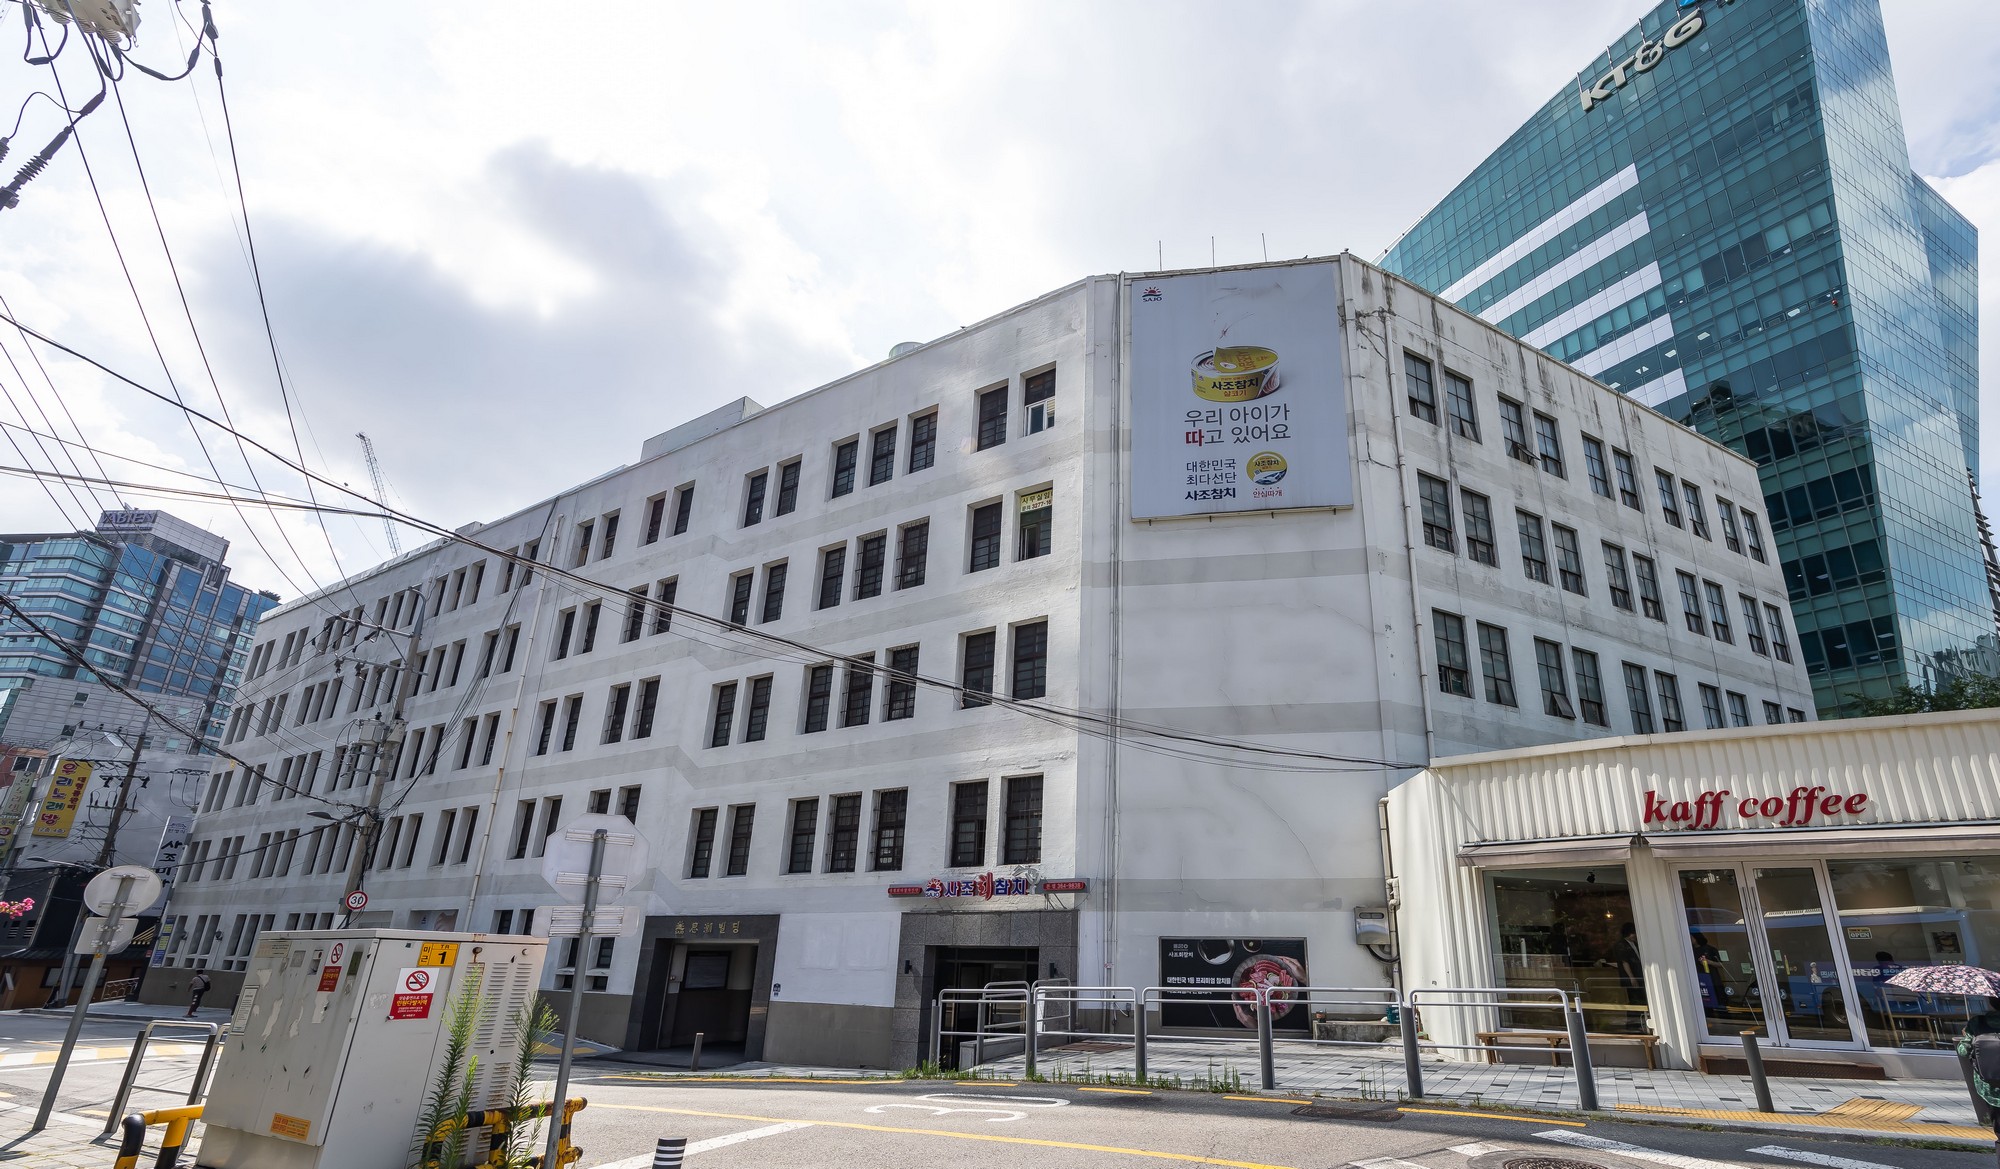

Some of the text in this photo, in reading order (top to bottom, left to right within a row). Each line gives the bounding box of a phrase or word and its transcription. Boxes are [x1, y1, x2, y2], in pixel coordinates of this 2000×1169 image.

[1579, 7, 1704, 112] KT&G
[1211, 377, 1259, 391] 사조참치
[1184, 403, 1291, 428] 우리 아이가
[1185, 423, 1291, 447] 따고 있어요
[1186, 458, 1237, 473] 대한민국
[1186, 472, 1237, 486] 최다선단
[1184, 487, 1237, 501] 사조참치
[1643, 786, 1868, 829] kaff coffee
[350, 895, 364, 906] 30
[438, 951, 447, 965] 1
[1166, 976, 1187, 984] 대한민국
